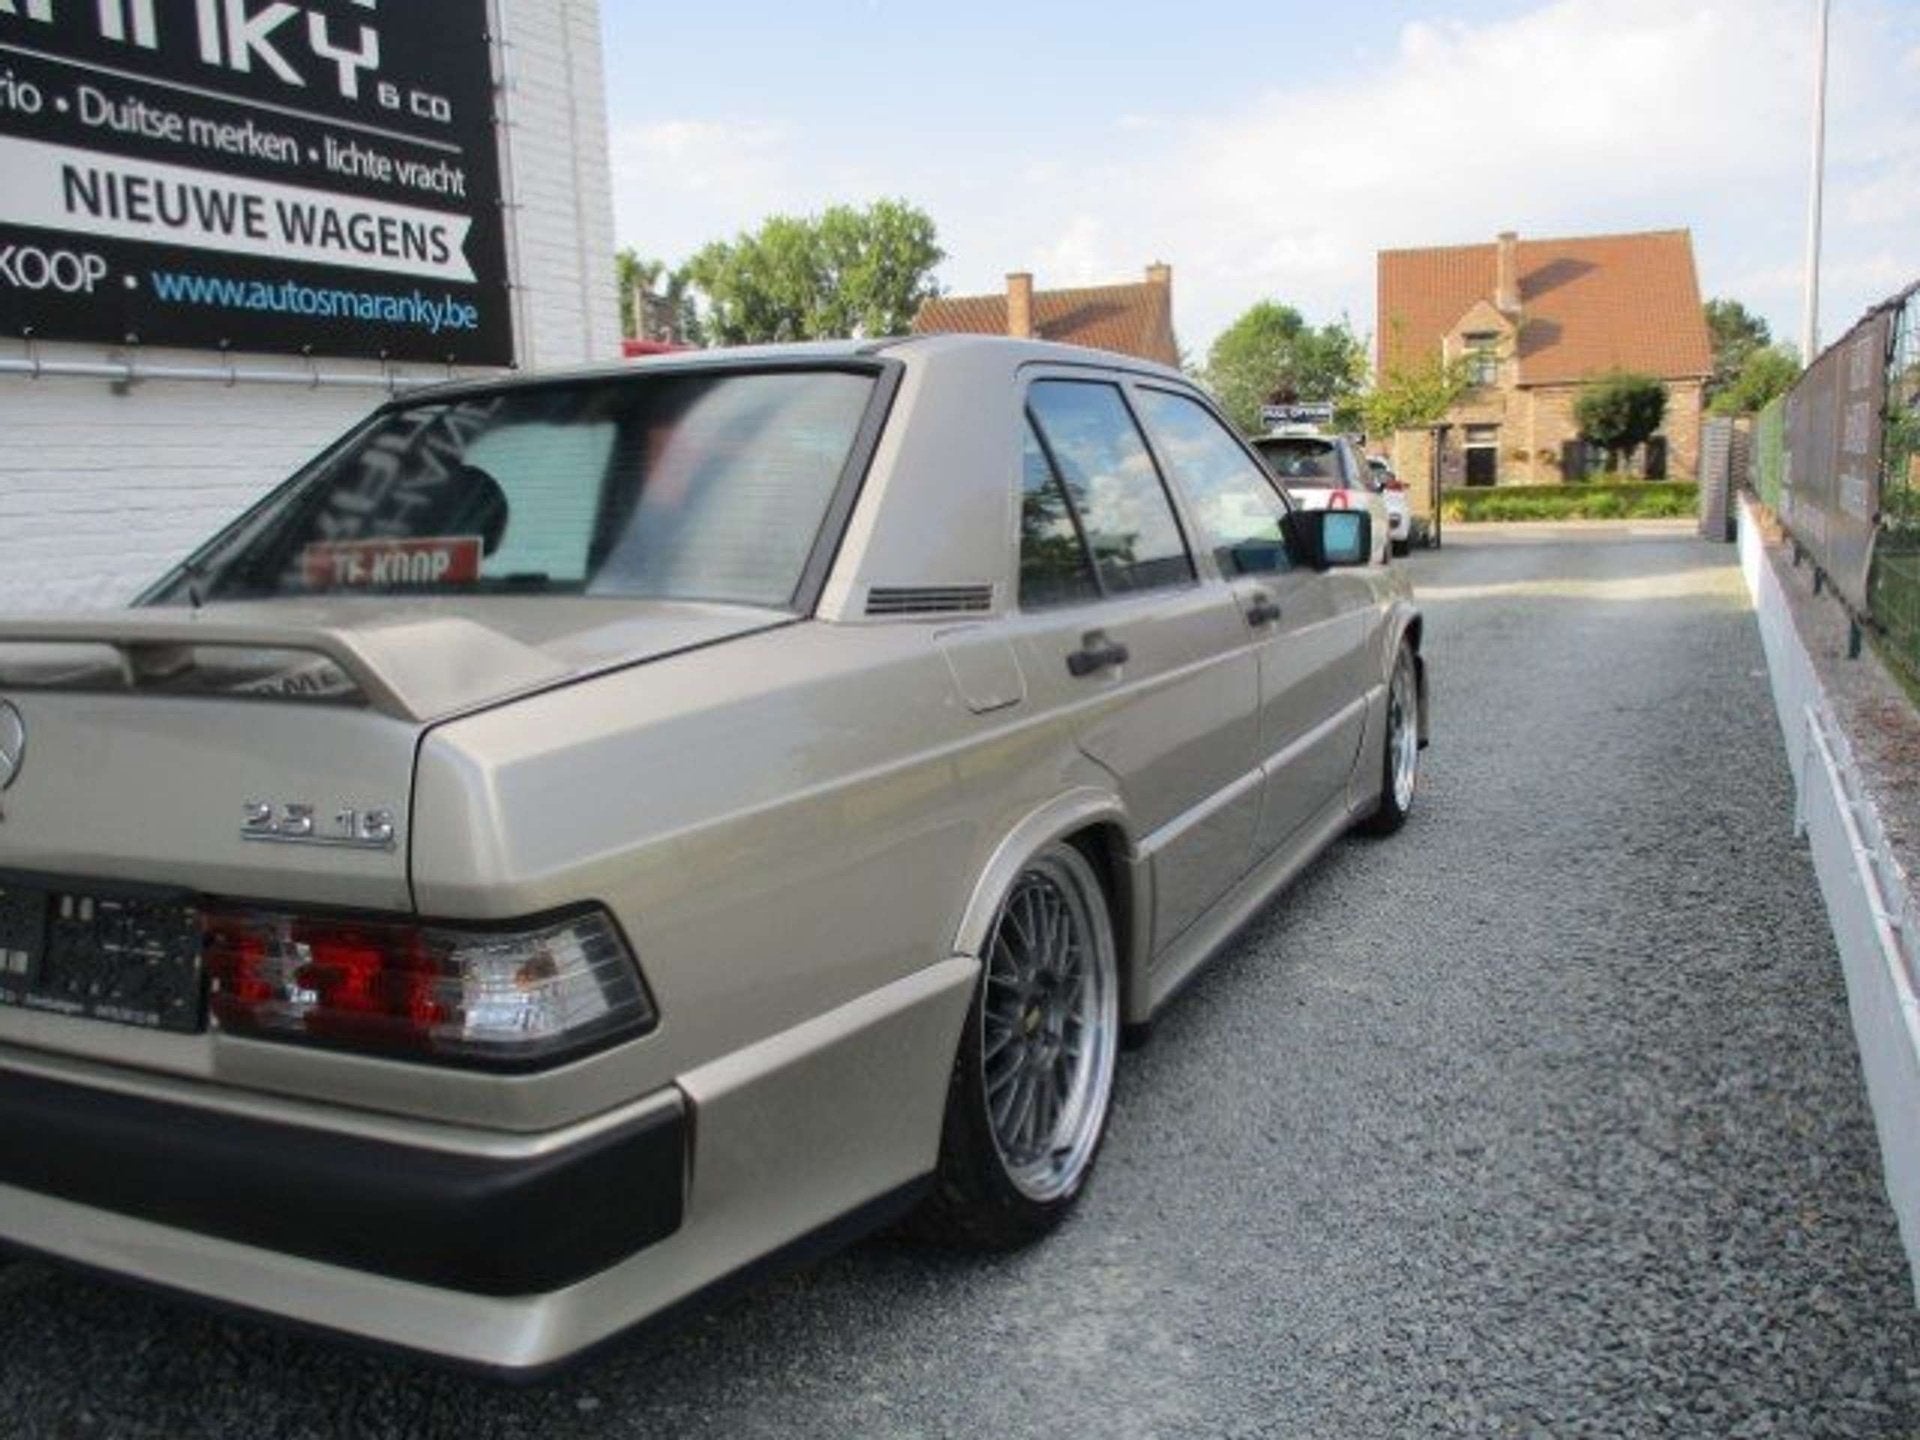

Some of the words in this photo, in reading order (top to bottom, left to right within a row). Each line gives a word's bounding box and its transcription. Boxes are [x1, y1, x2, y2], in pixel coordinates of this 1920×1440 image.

[78, 85, 184, 142] Duitse
[188, 119, 299, 165] merken
[324, 134, 392, 182] lichte
[395, 158, 467, 197] vracht
[62, 164, 269, 239] NIEUWE
[275, 199, 450, 265] WAGENS
[151, 270, 480, 334] www.autosmaranky.be
